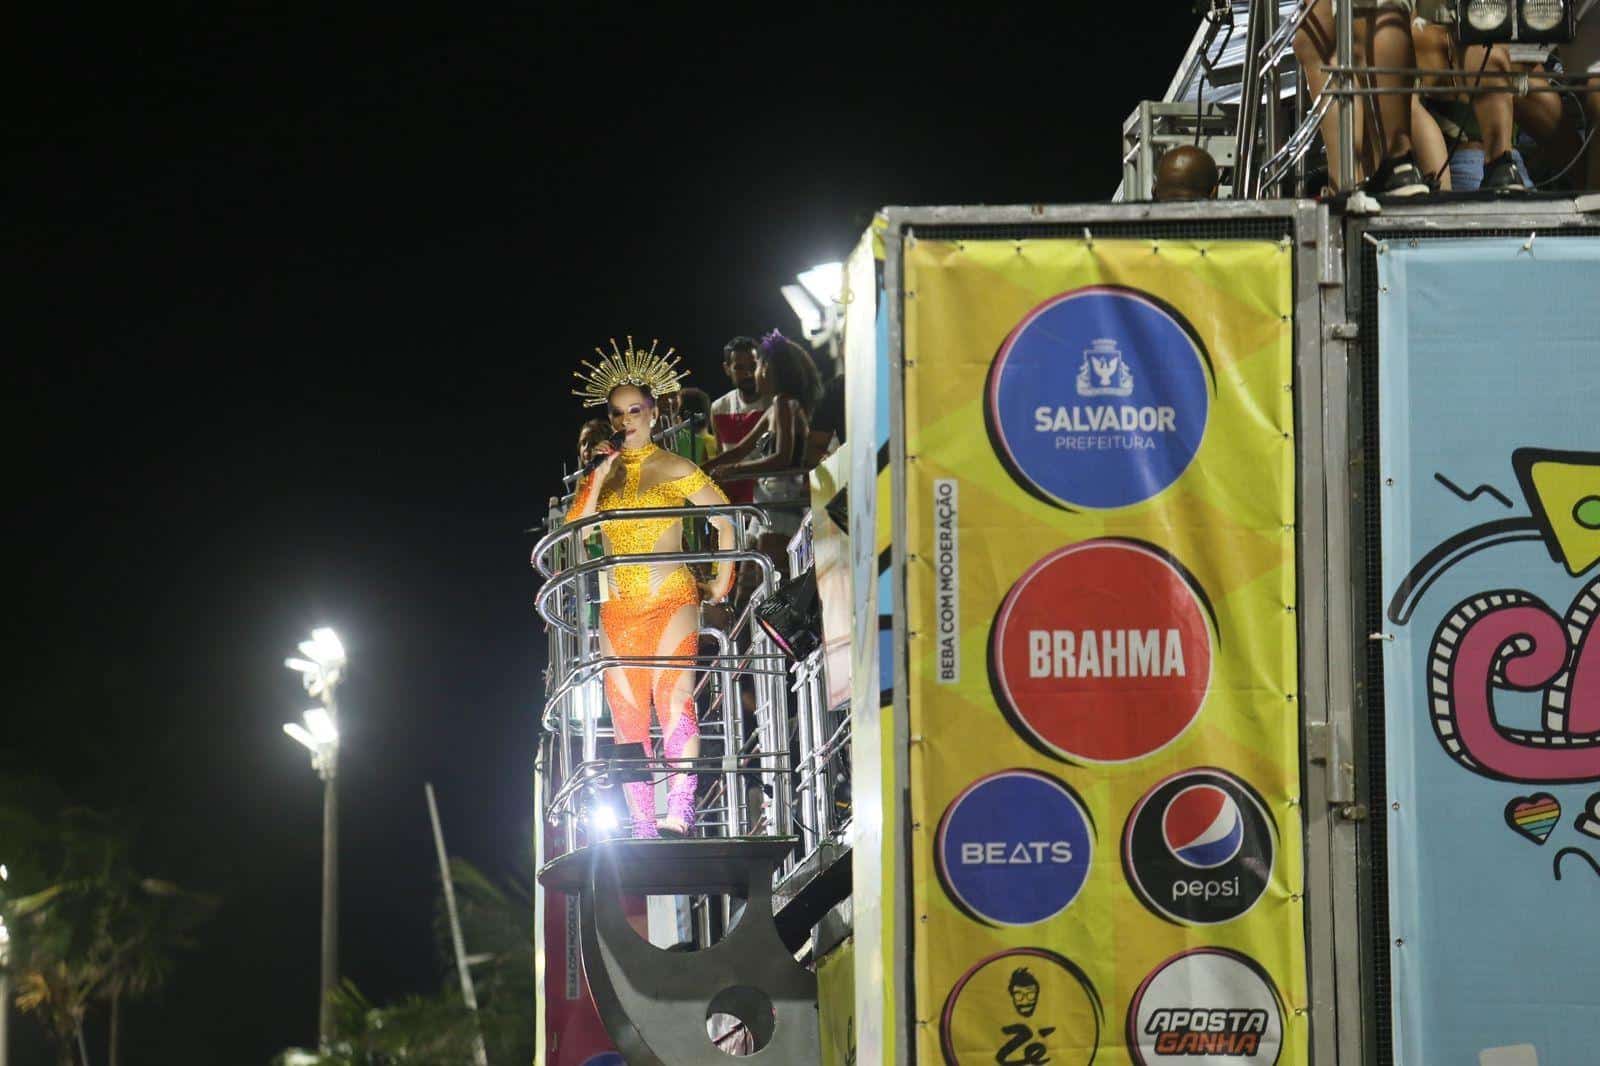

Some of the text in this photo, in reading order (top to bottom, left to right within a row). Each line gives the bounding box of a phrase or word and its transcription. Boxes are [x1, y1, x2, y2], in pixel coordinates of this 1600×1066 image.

[1034, 405, 1177, 432] SALVADOR
[1055, 434, 1157, 450] PREFEITURA
[936, 483, 956, 680] BEBA COM MODERAÇÃO
[1028, 628, 1186, 678] BRAHMA
[961, 841, 1073, 865] BEATS
[1172, 876, 1240, 901] pepsi
[1146, 1009, 1268, 1034] APOSTA
[995, 1023, 1056, 1066] Zé
[1154, 1030, 1260, 1056] GANHA
